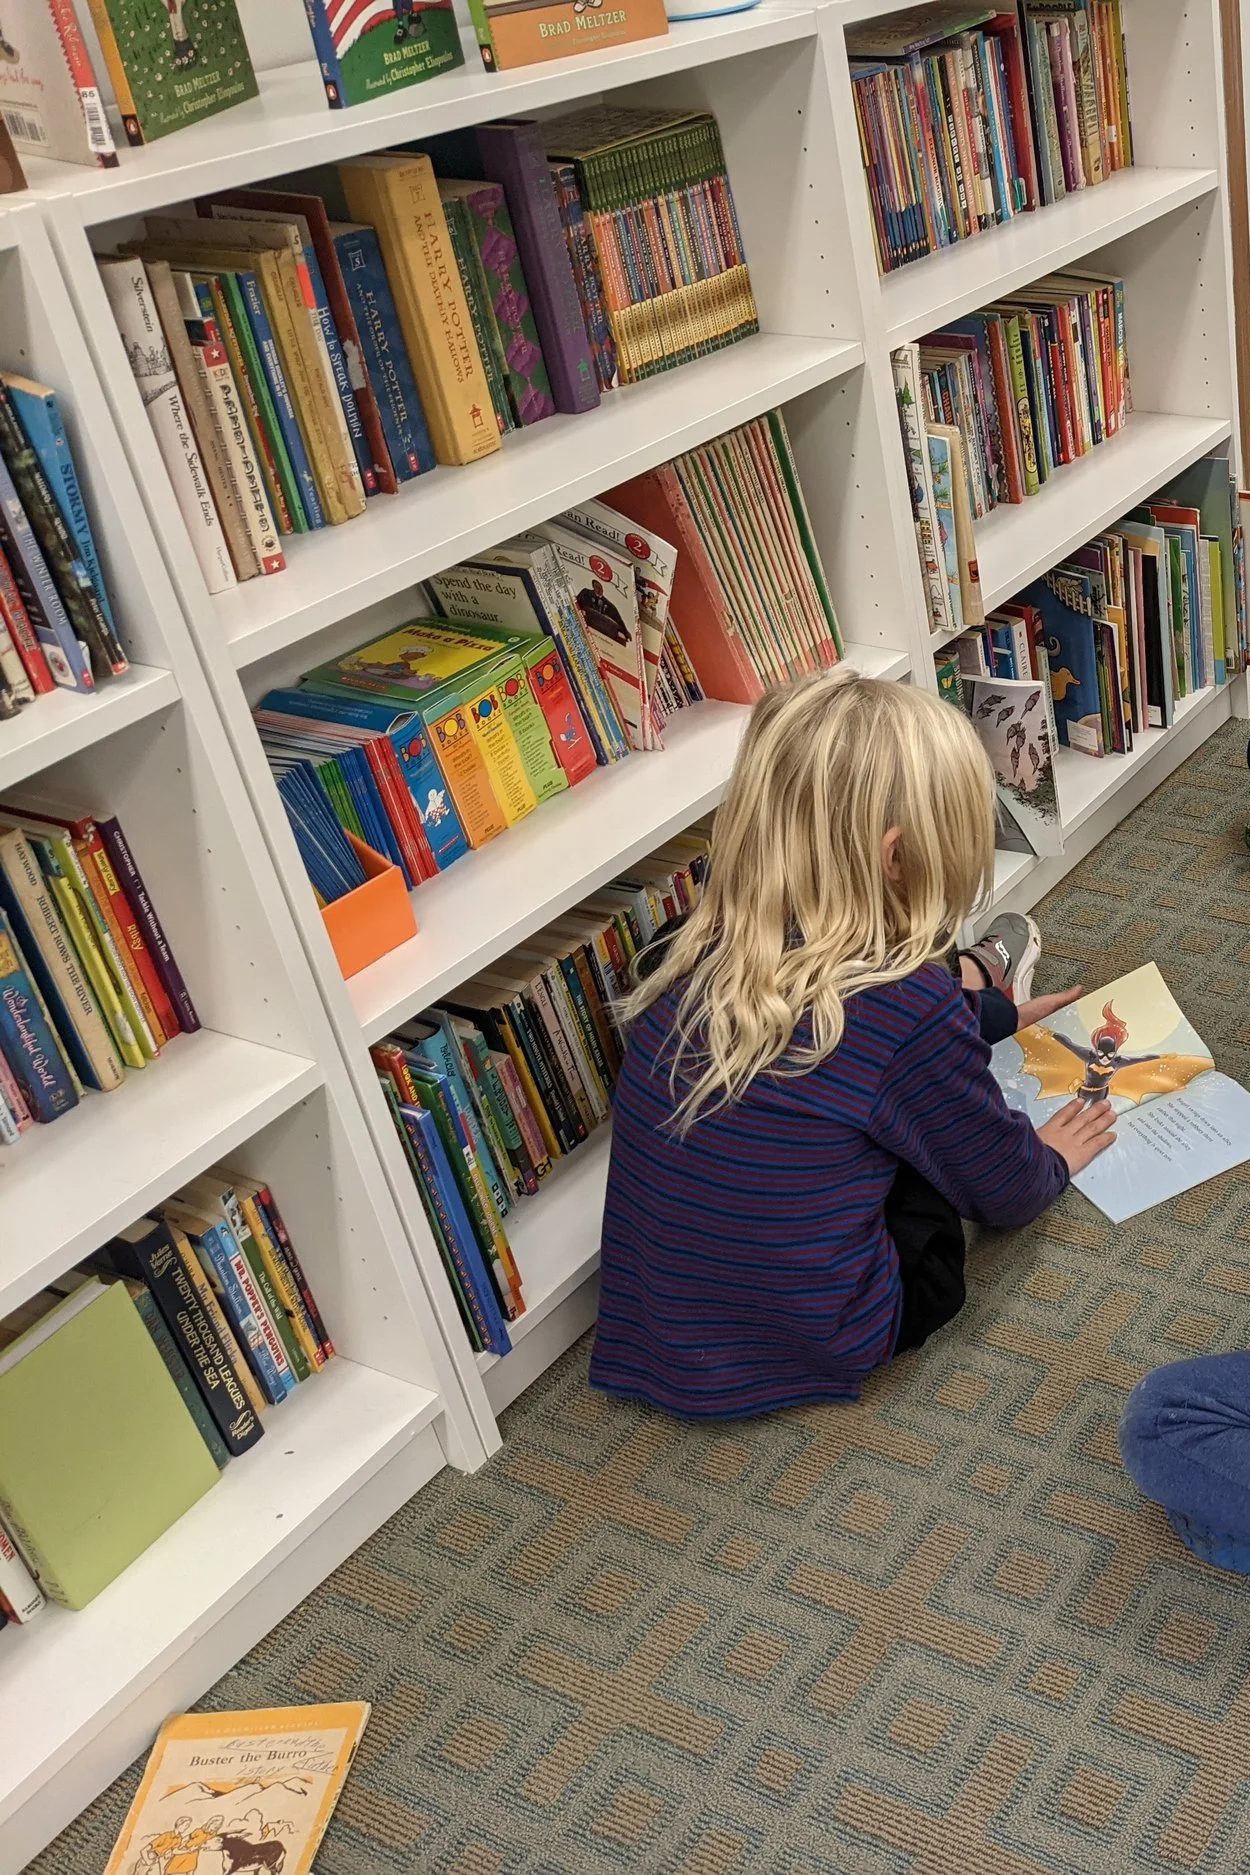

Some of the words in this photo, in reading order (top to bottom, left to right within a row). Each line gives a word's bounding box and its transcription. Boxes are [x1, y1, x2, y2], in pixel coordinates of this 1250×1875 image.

[539, 21, 571, 38] BRAD
[575, 10, 627, 31] MELTZER
[383, 50, 402, 65] BRAD
[402, 40, 432, 59] MELTZER
[174, 82, 193, 97] BRAD
[192, 71, 220, 90] MELTZER
[390, 61, 426, 82] Christopher
[928, 137, 938, 176] ELEANOR
[579, 224, 594, 271] HARRY
[590, 274, 603, 324] POTTER
[132, 276, 153, 333] Silverstein
[247, 280, 262, 315] Frazier
[414, 215, 425, 241] AND
[422, 241, 433, 267] THE
[430, 272, 450, 325] DEATHLY
[444, 329, 464, 383] HALLOWS
[424, 212, 452, 292] HARRY
[449, 300, 474, 379] POTTER
[458, 257, 478, 318] HARRY
[475, 324, 493, 382] POTTER
[366, 290, 390, 353] HARRY
[385, 360, 408, 422] POTTER
[317, 305, 334, 336] How
[327, 338, 336, 351] to
[342, 394, 363, 438] DOLPHIN
[168, 395, 184, 433] Where
[179, 432, 189, 450] the
[185, 452, 207, 499] Sidewalk
[200, 501, 212, 527] Ends
[60, 463, 89, 534] STORMY
[81, 540, 91, 558] Jim
[307, 486, 322, 524] Yearling
[586, 517, 620, 541] Read!
[633, 541, 643, 552] 2
[23, 532, 36, 550] THE
[32, 555, 53, 591] WINTER
[48, 593, 68, 624] ROOM
[596, 562, 605, 574] 2
[434, 575, 472, 589] Spend
[473, 579, 493, 592] the
[496, 583, 516, 599] day
[442, 590, 469, 603] with
[471, 596, 480, 605] a
[450, 604, 503, 623] dinosaur.
[402, 627, 441, 640] Make
[454, 638, 495, 651] Pizza
[535, 658, 561, 688] BOB
[1019, 643, 1029, 677] CLAIRE
[498, 673, 526, 702] BOB
[471, 694, 499, 724] BOB
[436, 713, 466, 743] BOB
[400, 734, 426, 763] BOB
[113, 830, 136, 877] CHRISTOPHER
[138, 892, 150, 913] Tackle
[146, 911, 161, 942] Without
[159, 945, 170, 962] Team
[14, 842, 38, 886] HAYWOOD
[37, 895, 58, 934] ROBERT
[52, 933, 71, 966] ROWS
[66, 963, 80, 987] THE
[75, 985, 93, 1016] RIVER
[127, 924, 144, 952] Ribsy
[535, 981, 548, 1008] L'ENGLE
[579, 1005, 590, 1022] STORY
[3, 986, 41, 1056] Wonderlandiful
[32, 1055, 57, 1089] World
[525, 1028, 535, 1041] TWO
[401, 1064, 413, 1087] LOOK
[408, 1085, 419, 1101] AND
[258, 1271, 267, 1284] The
[262, 1282, 273, 1295] Call
[205, 1299, 224, 1334] Friend
[234, 1259, 244, 1276] MR.
[242, 1276, 264, 1326] POPPER'S
[260, 1321, 286, 1368] PENGUINS
[269, 1297, 279, 1306] the
[274, 1305, 284, 1319] Wild
[172, 1266, 199, 1310] TWENTY
[192, 1309, 225, 1365] THOUSAND
[219, 1363, 245, 1410] LEAGUES
[176, 1311, 200, 1348] UNDER
[194, 1344, 210, 1368] THE
[204, 1366, 221, 1390] SEA
[190, 1755, 234, 1767] Buster
[240, 1752, 262, 1763] the
[267, 1749, 307, 1761] Burro
